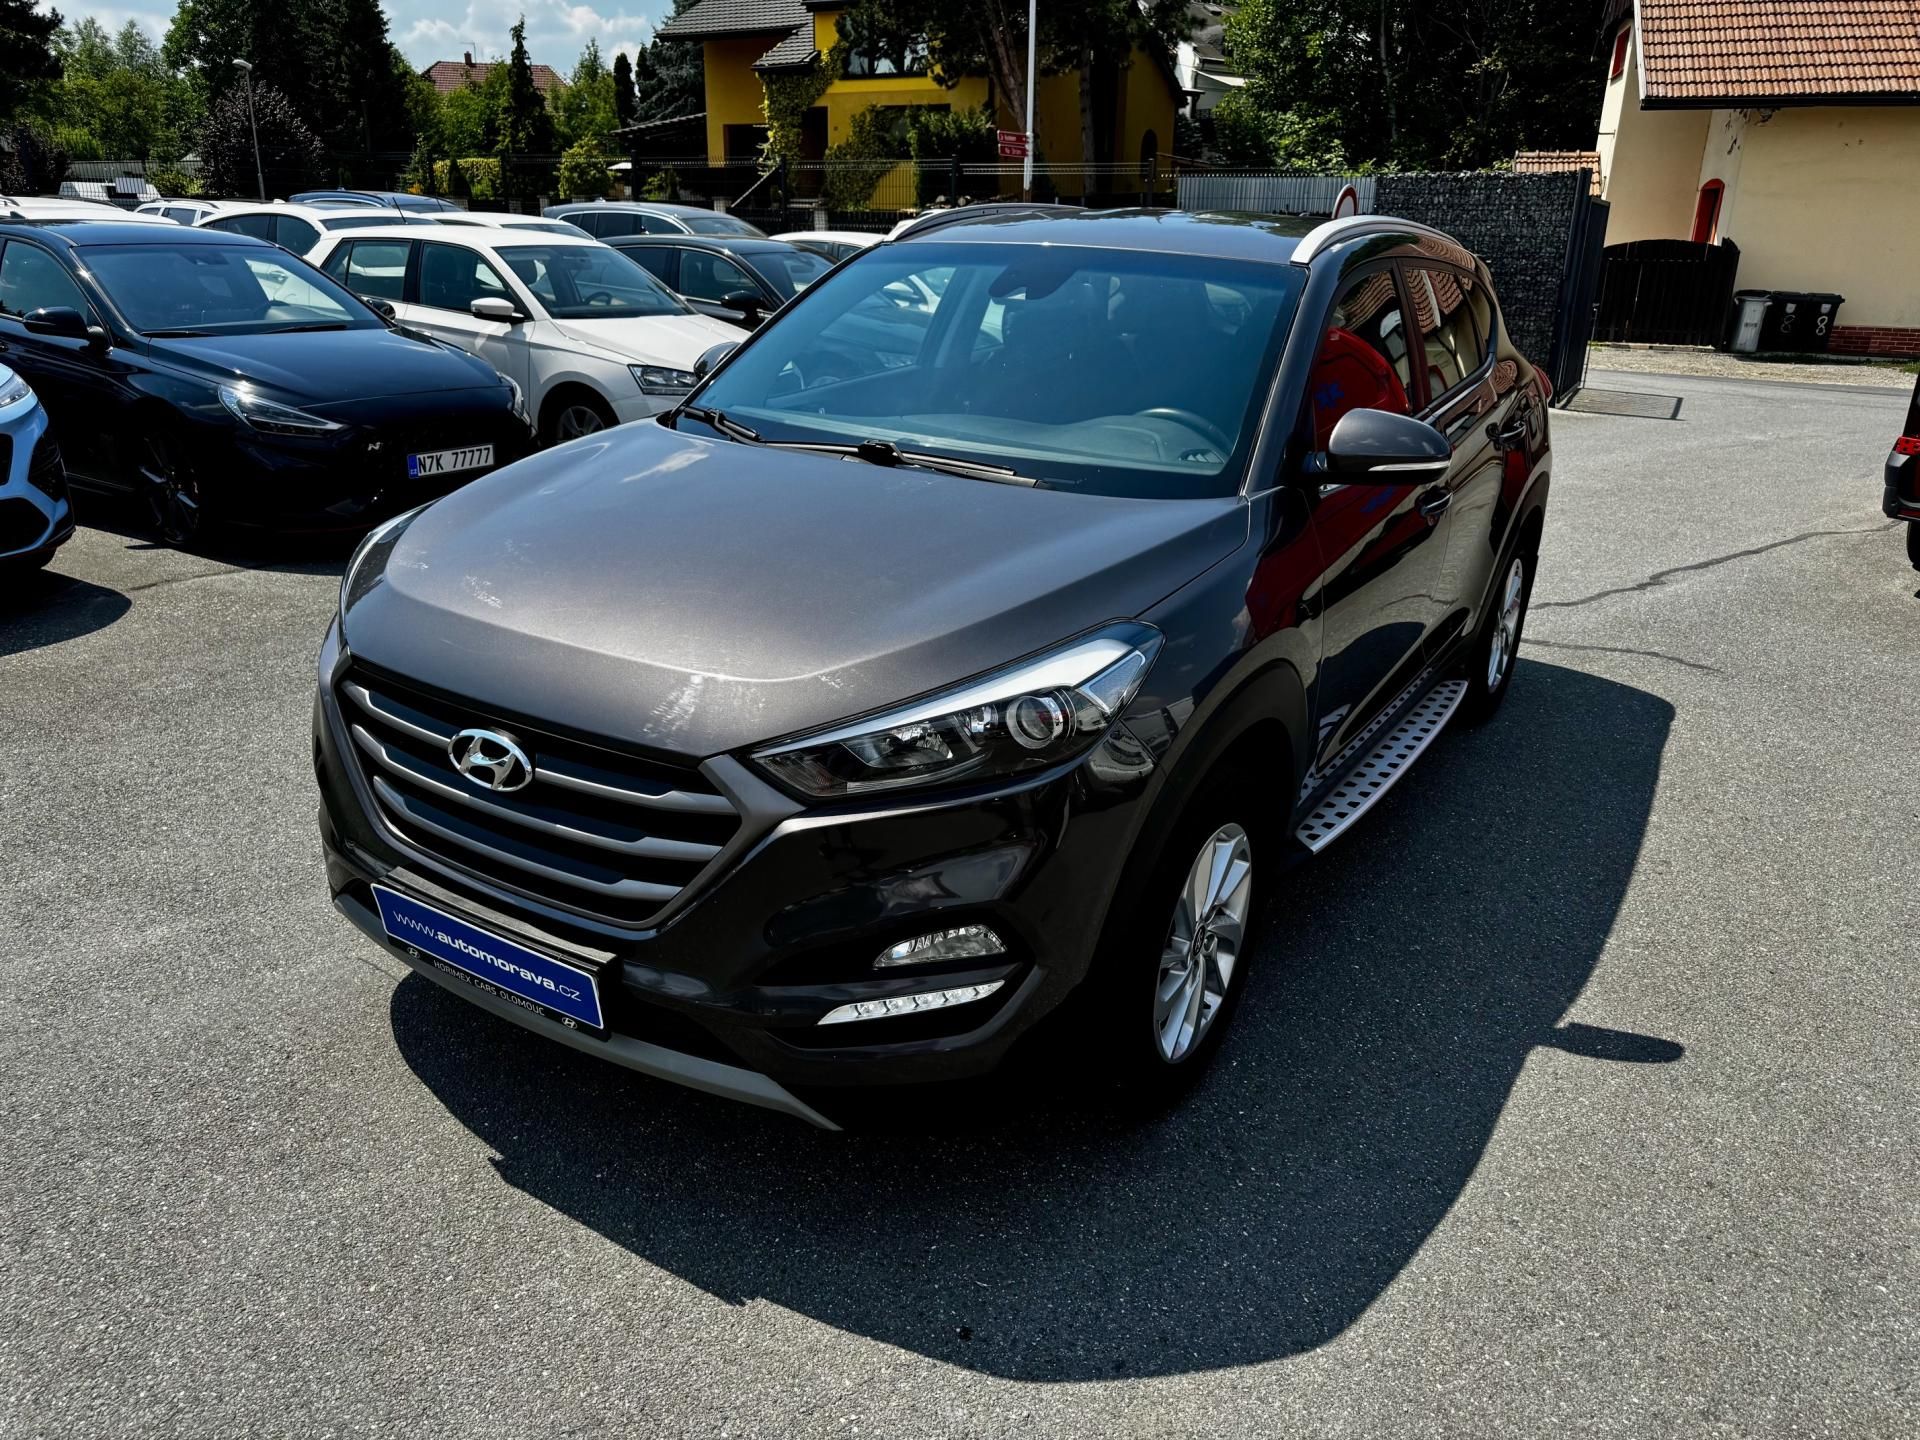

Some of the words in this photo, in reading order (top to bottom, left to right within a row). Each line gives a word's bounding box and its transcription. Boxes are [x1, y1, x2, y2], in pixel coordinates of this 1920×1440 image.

[1815, 315, 1828, 336] 8
[418, 454, 443, 473] N7K
[452, 447, 490, 468] 77777
[393, 910, 582, 1002] www.automorava.cz
[433, 959, 472, 984] HORIMEX
[474, 979, 497, 996] CARS
[499, 990, 545, 1016] OLOMOUC
